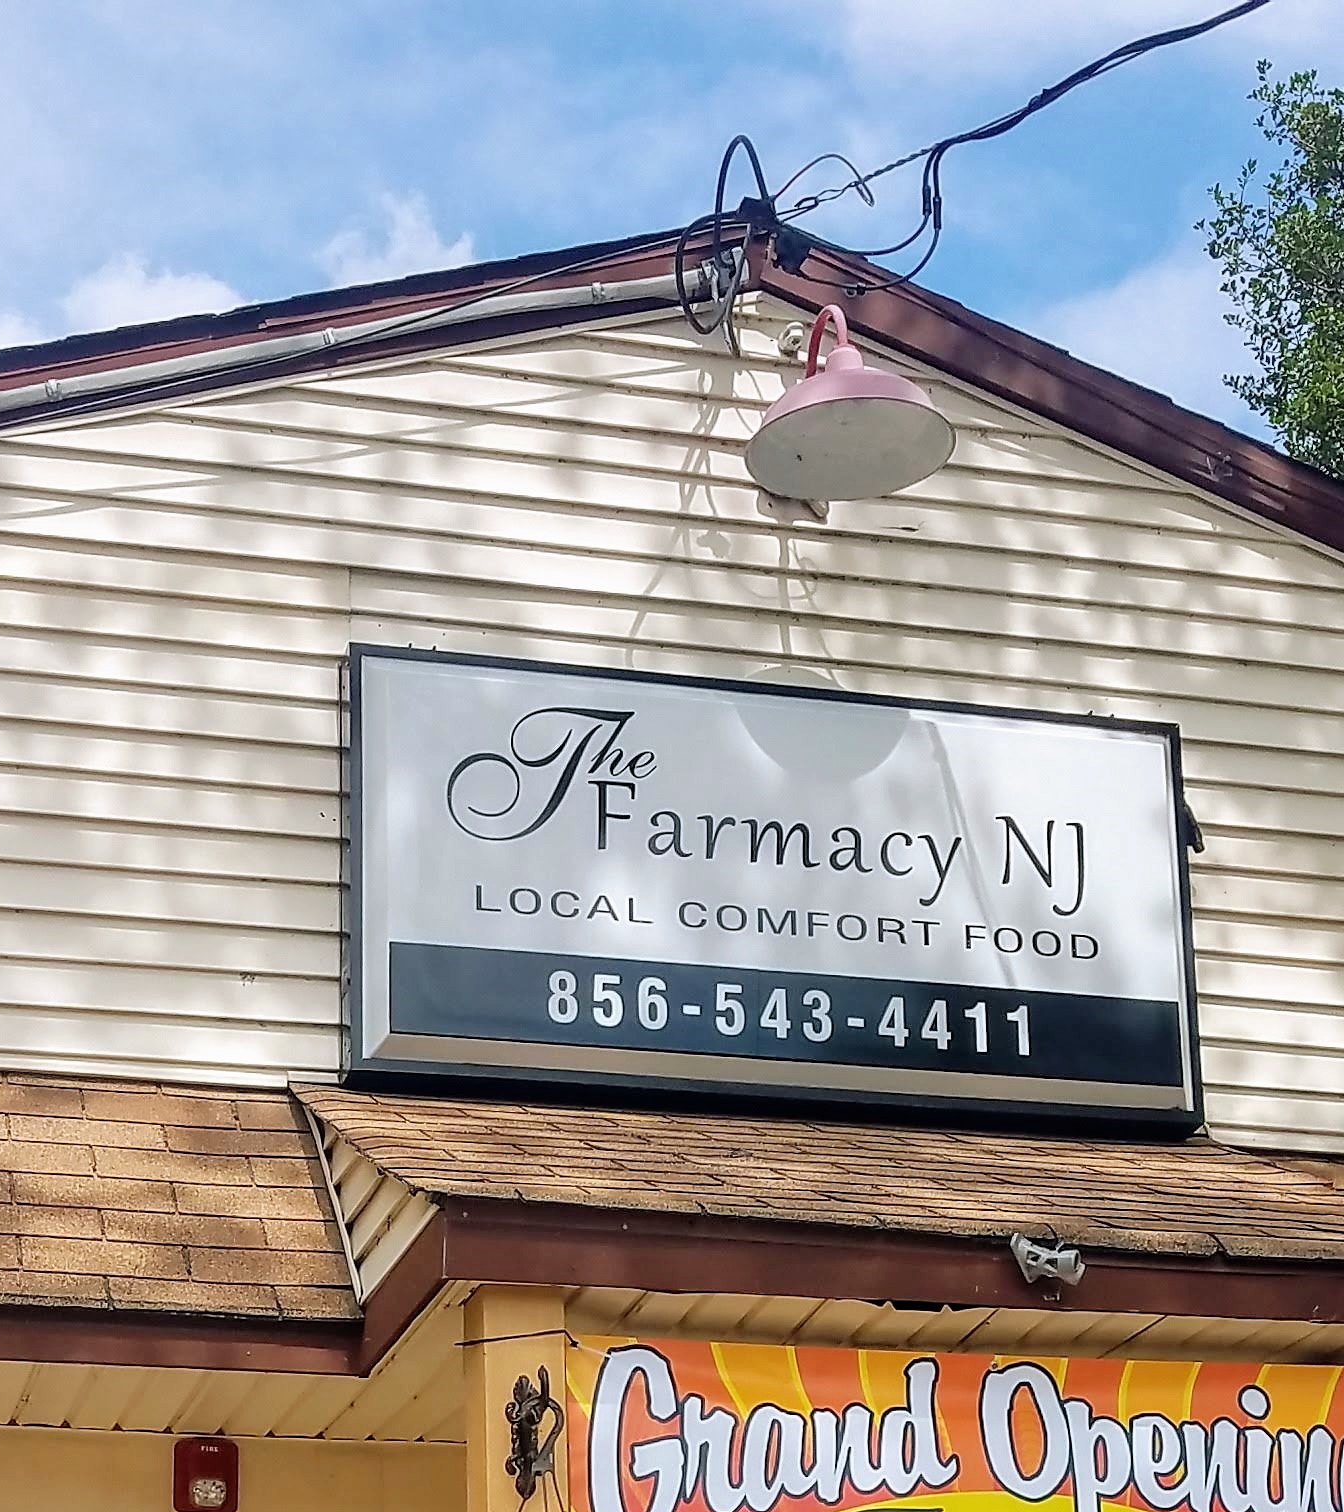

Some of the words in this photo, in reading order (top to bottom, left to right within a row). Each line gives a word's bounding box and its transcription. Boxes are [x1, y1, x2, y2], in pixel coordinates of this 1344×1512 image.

[447, 707, 657, 841] The
[588, 780, 962, 906] Farmacy
[996, 815, 1089, 916] NJ
[475, 884, 654, 925] LOCAL
[678, 900, 941, 948] COMFORT
[966, 924, 1101, 961] FOOD
[548, 969, 1031, 1057] 856-543-4411
